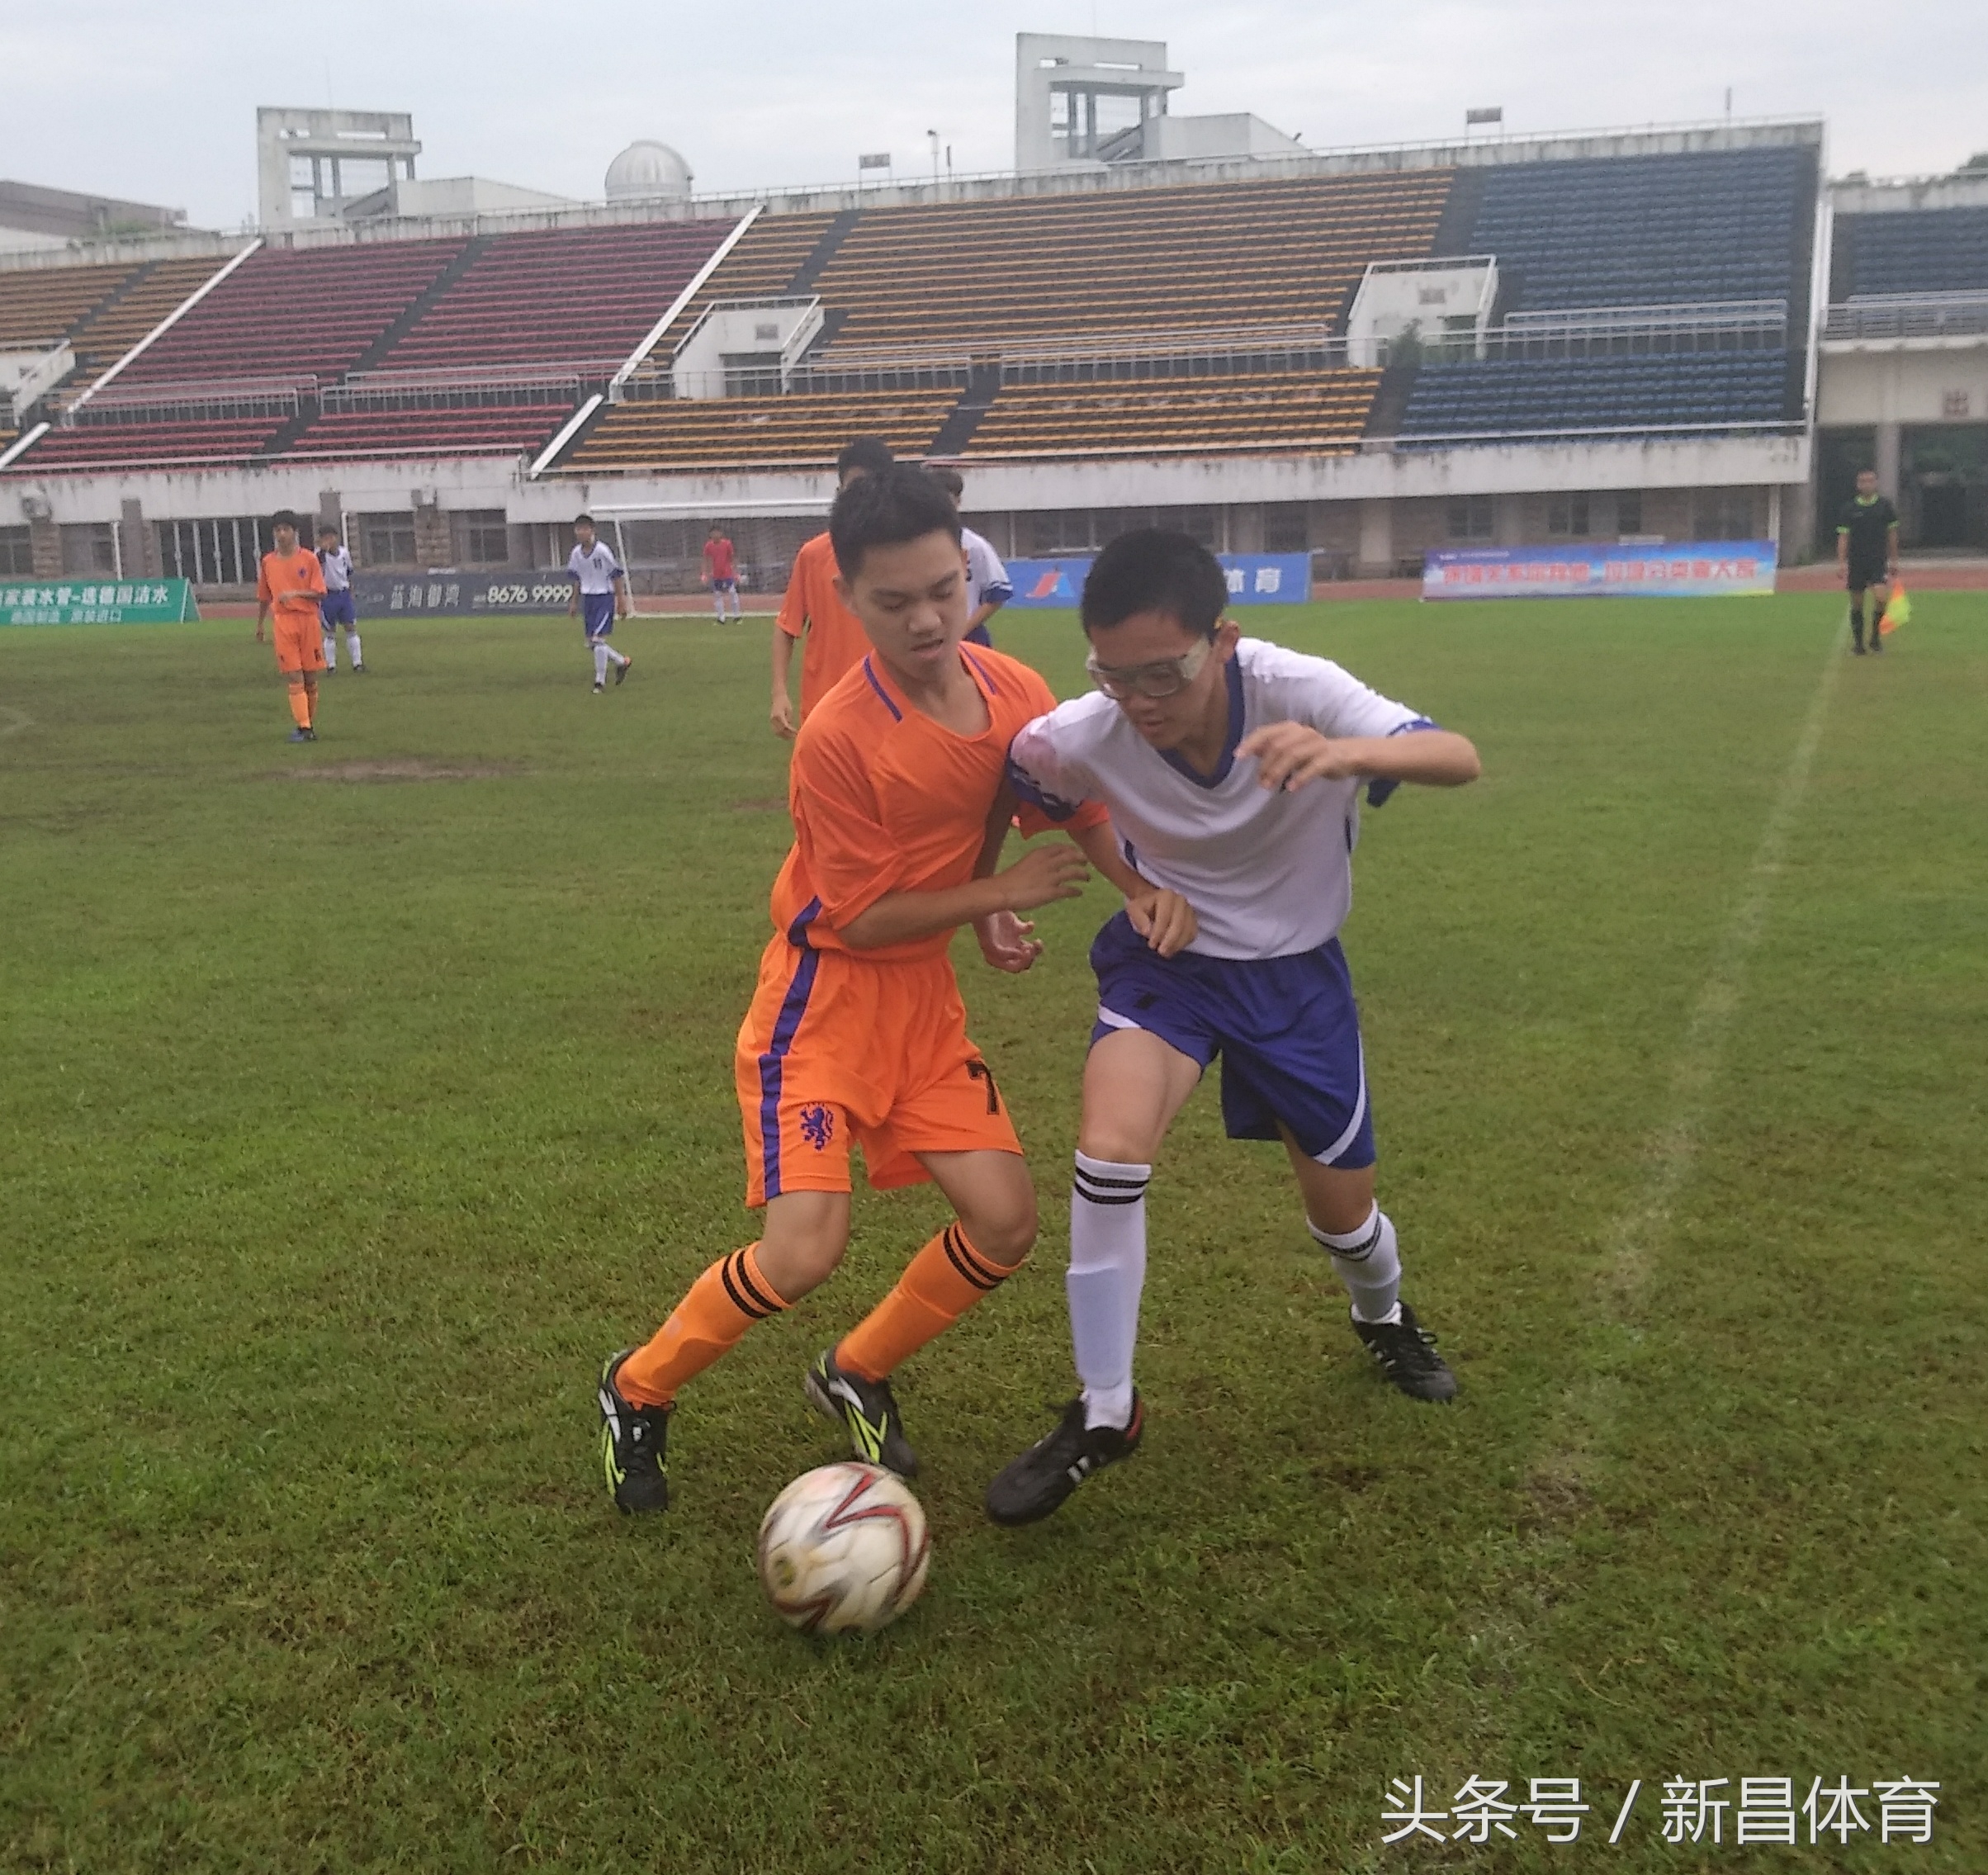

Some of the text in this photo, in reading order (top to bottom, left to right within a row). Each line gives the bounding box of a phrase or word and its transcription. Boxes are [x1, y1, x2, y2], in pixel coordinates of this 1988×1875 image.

[487, 585, 528, 604] 8676
[532, 584, 573, 603] 9999
[965, 1060, 1000, 1115] 7
